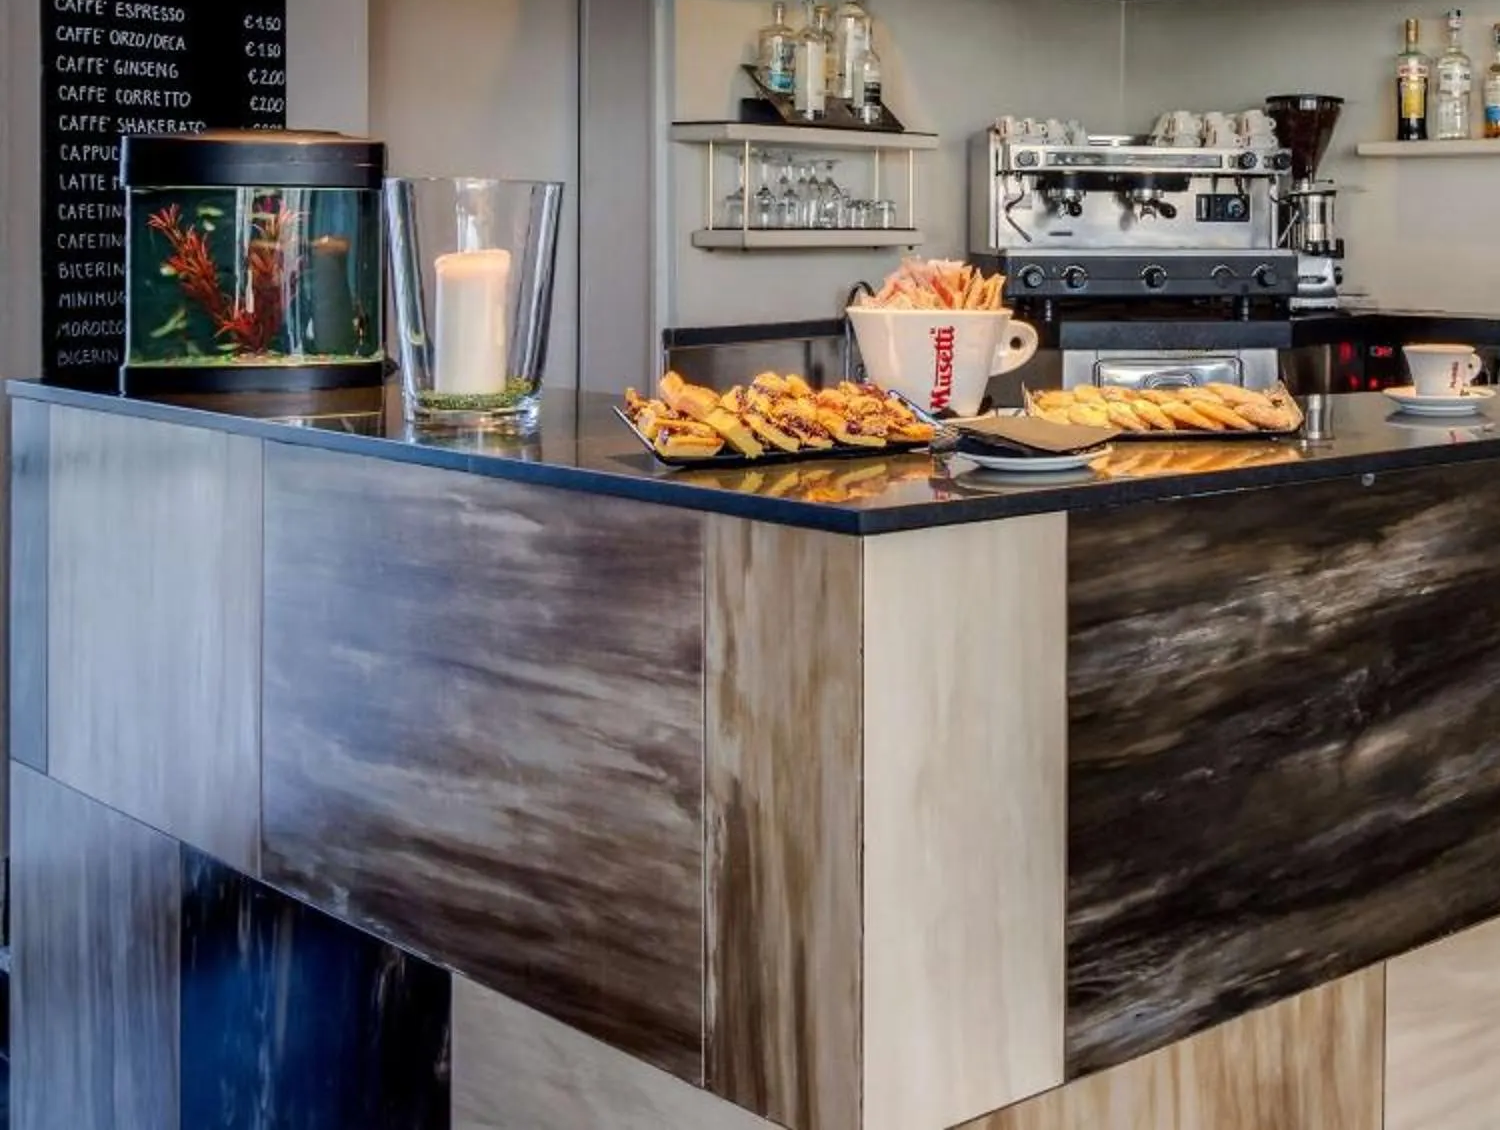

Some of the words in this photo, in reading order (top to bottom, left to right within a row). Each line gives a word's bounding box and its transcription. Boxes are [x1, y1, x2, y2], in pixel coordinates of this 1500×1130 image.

[115, 1, 185, 22] ESPRESSO
[109, 30, 186, 51] ORZO/DECA
[113, 58, 179, 79] GINSENG
[115, 88, 191, 108] CORRETTO
[60, 144, 121, 161] CAPPUC
[59, 173, 106, 191] LATTE
[58, 203, 126, 220] CAFETIN
[57, 233, 126, 249] CAFETIN
[930, 326, 955, 410] Musetti
